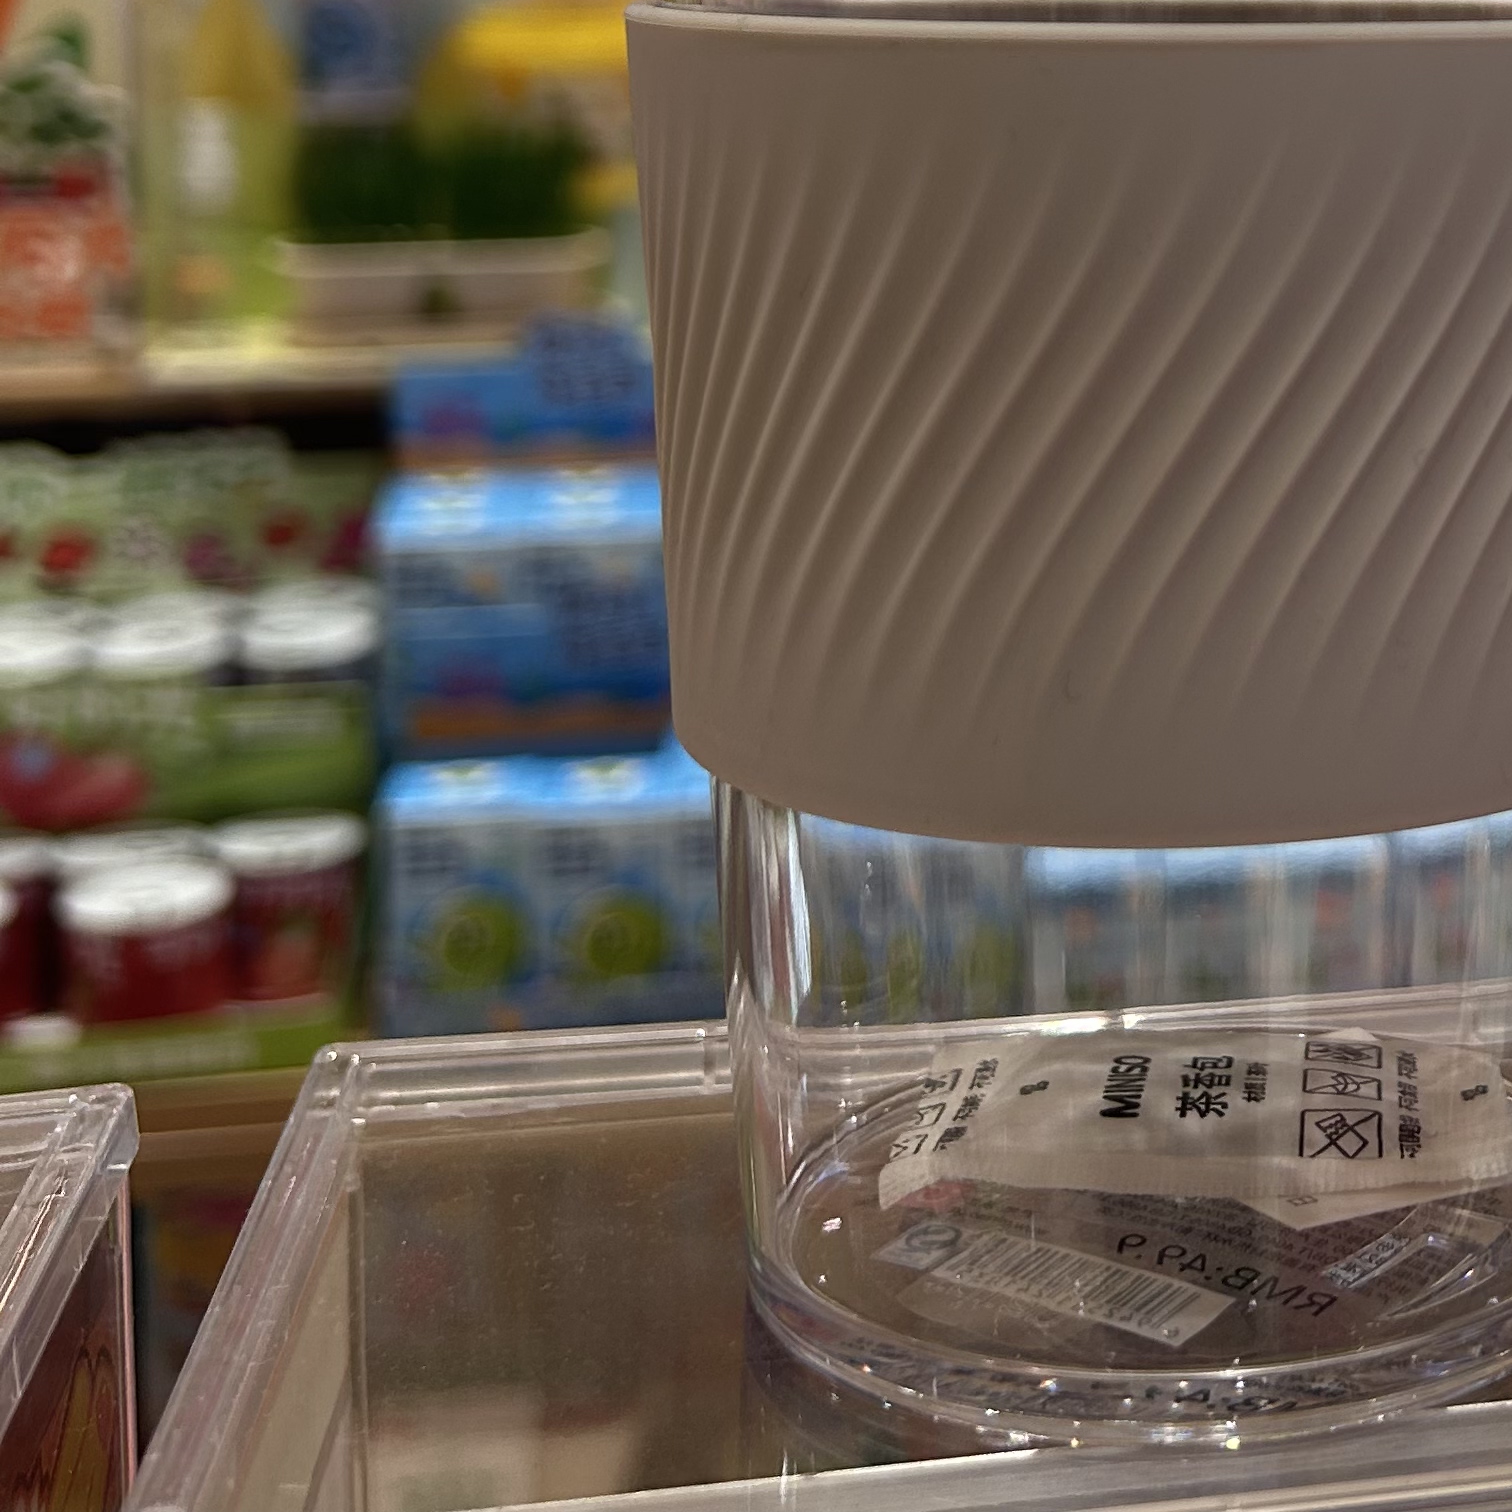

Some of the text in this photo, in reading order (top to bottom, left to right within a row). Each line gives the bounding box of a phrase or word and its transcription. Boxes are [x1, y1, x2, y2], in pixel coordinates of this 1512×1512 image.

[1099, 1054, 1152, 1118] MINISO
[1175, 1055, 1234, 1119] 茶香包
